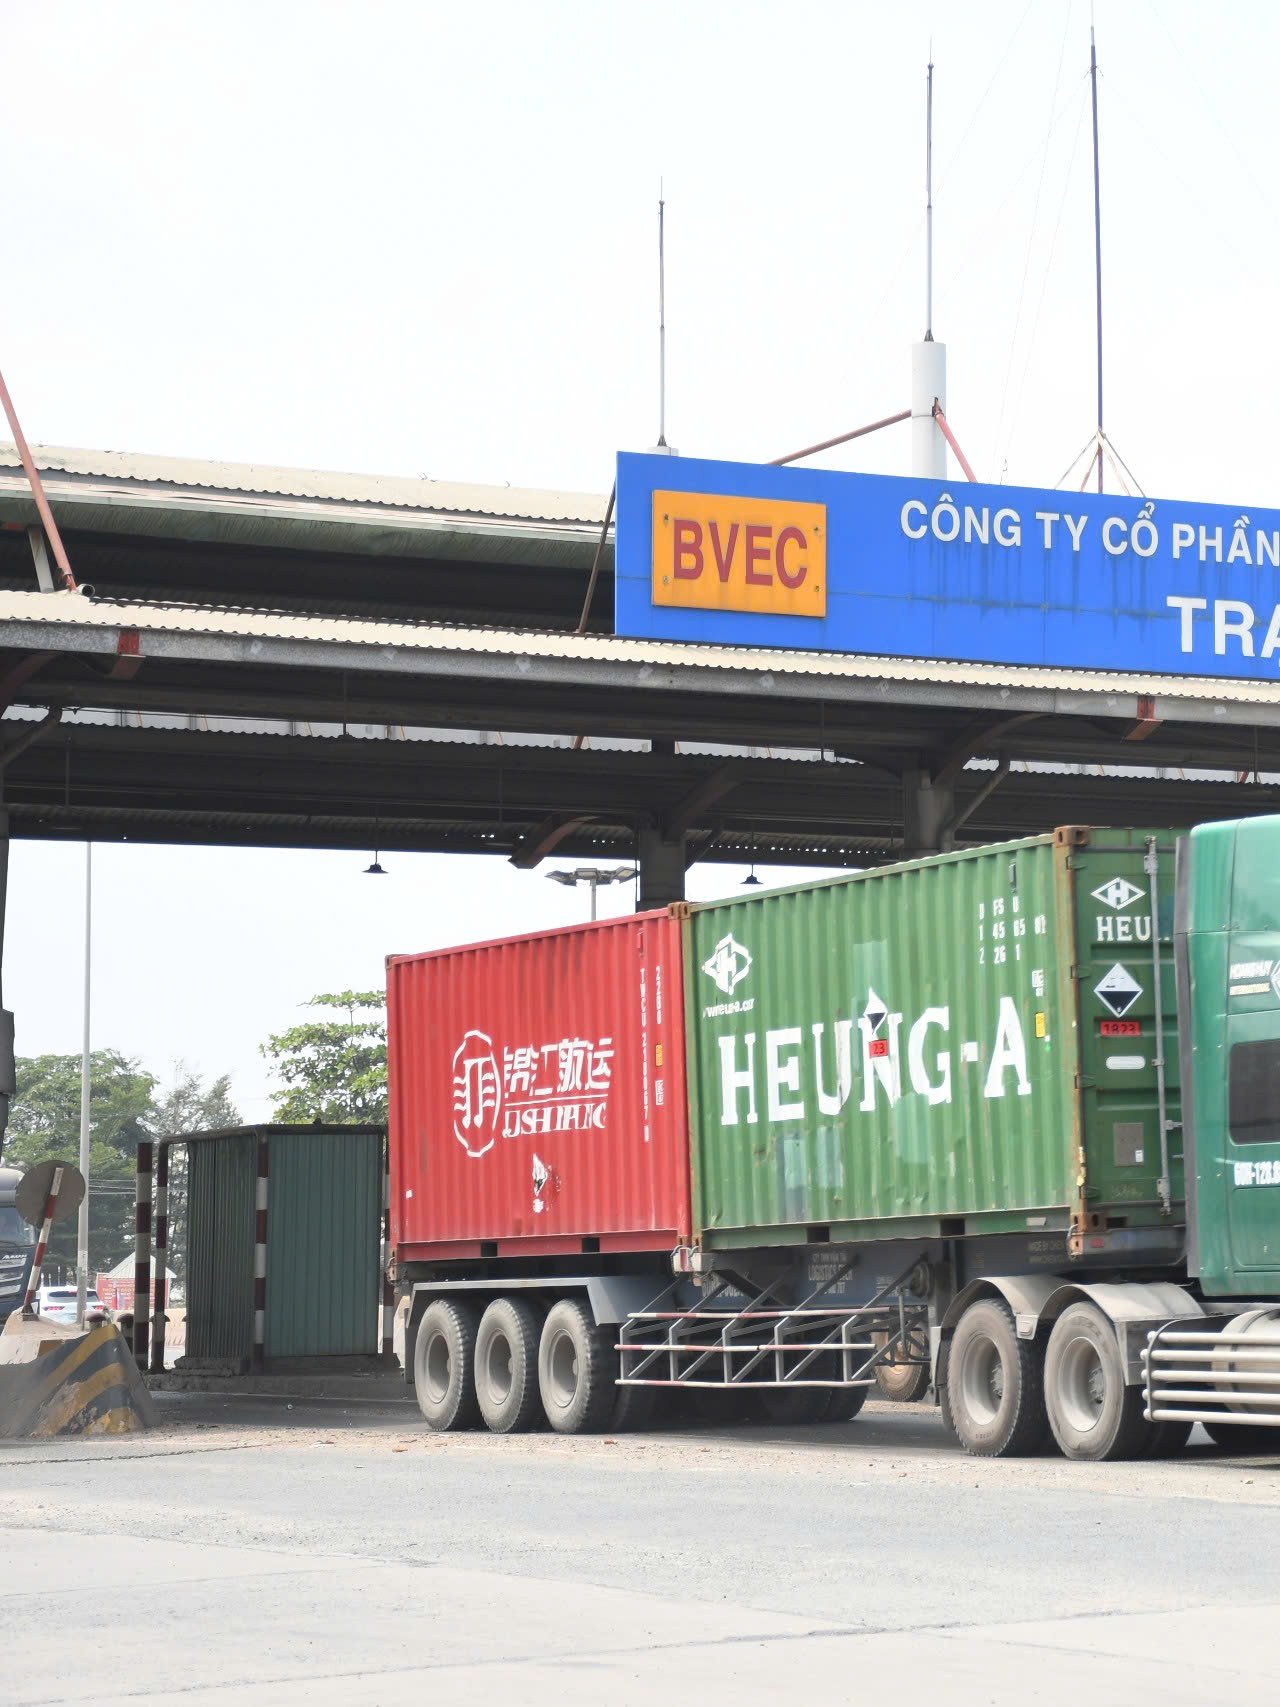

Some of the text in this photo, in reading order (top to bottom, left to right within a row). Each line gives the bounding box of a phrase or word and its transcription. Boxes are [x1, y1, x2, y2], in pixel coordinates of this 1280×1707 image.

[673, 519, 808, 589] BVEC
[901, 494, 1021, 547] CÔNG
[1035, 511, 1088, 552] TY
[1102, 501, 1159, 557] CỔ
[1172, 515, 1280, 567] PHẦN
[718, 996, 1032, 1126] HEUNG-A
